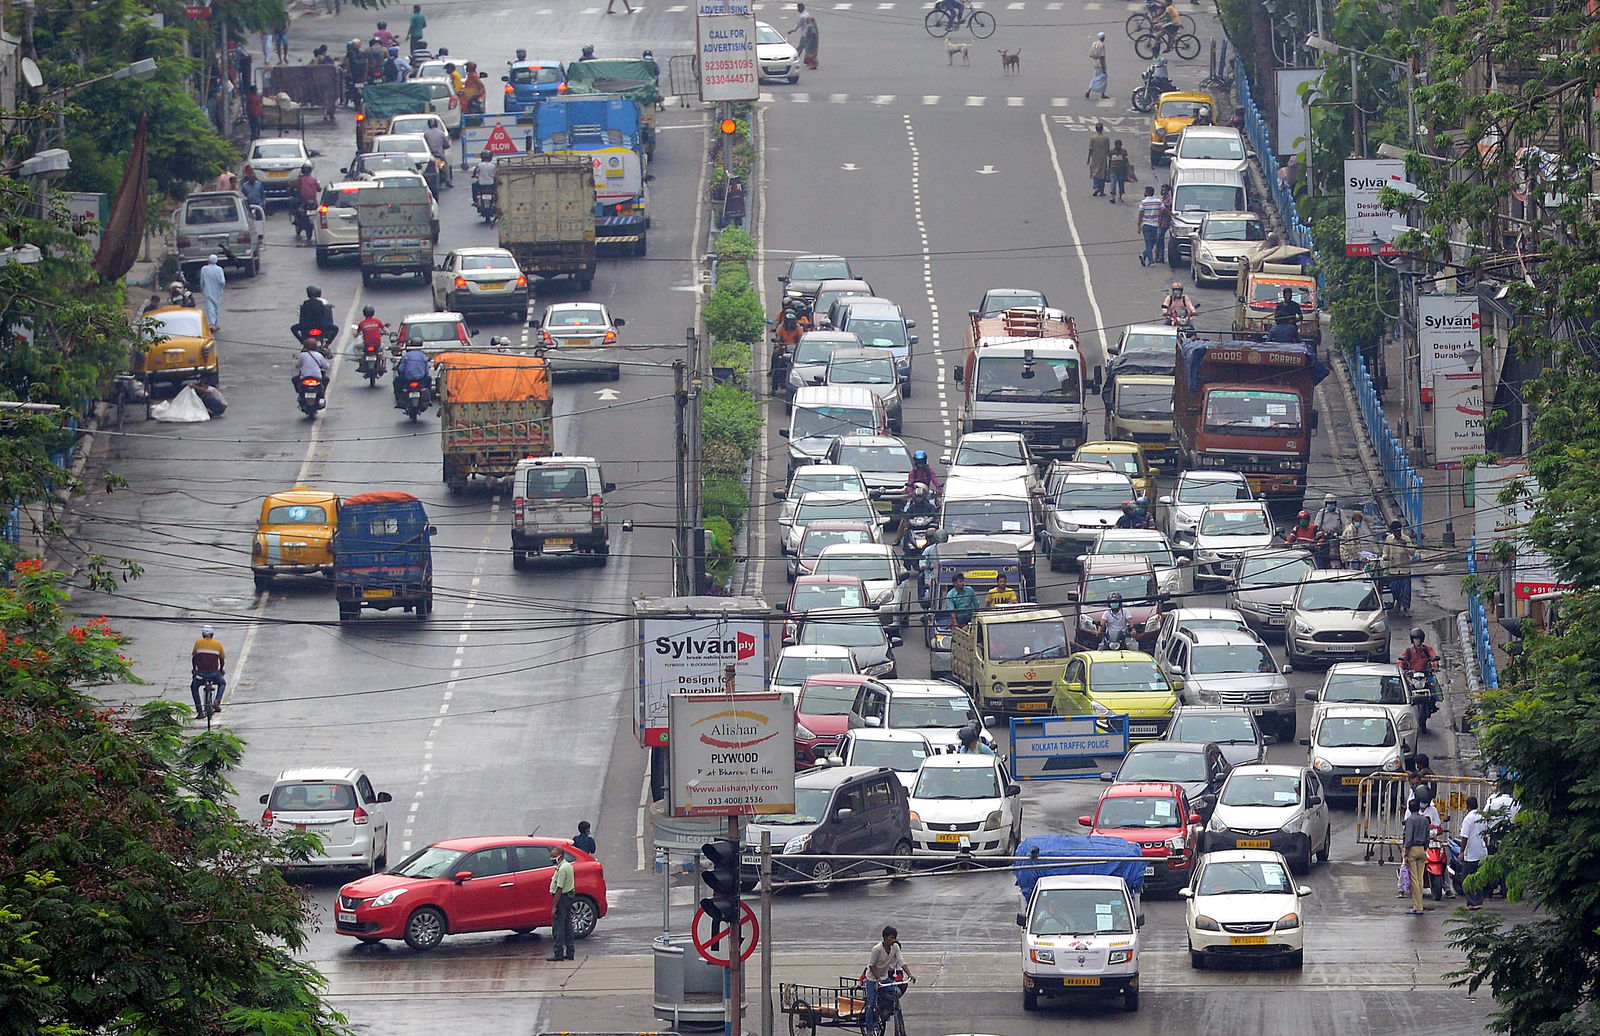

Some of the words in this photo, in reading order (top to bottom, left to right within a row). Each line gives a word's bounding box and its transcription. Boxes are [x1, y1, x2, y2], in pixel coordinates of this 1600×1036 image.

[709, 30, 728, 39] CALL
[730, 30, 744, 38] FOR
[704, 42, 753, 52] ADVERTISING
[706, 74, 754, 84] 9330444573
[1434, 342, 1461, 351] Design
[1210, 352, 1242, 361] GOODS
[738, 640, 754, 654] ply
[679, 676, 714, 685] Design
[711, 724, 757, 736] Alishan
[1032, 743, 1058, 752] KOLKATA
[1060, 742, 1086, 751] TRAFFIC
[1087, 740, 1110, 750] POLICE
[711, 753, 758, 764] PLYWOOD
[693, 784, 778, 793] www.alishanply.com
